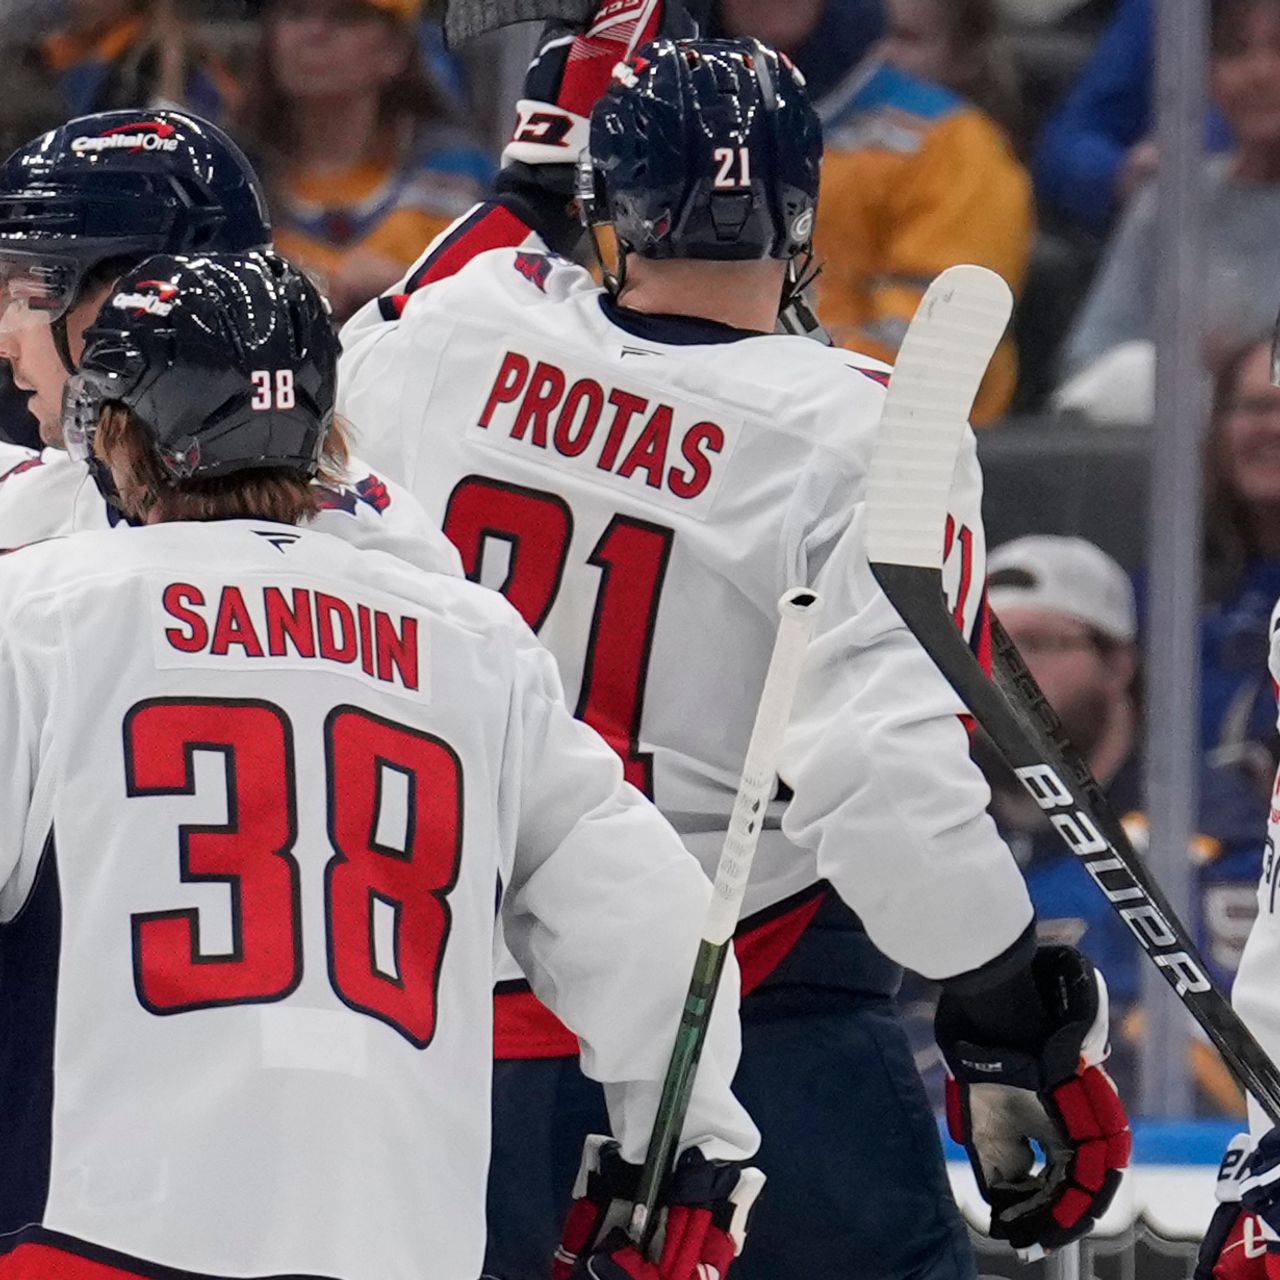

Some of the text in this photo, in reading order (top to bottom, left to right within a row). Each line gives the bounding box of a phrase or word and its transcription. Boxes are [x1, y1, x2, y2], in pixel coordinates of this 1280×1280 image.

[713, 147, 752, 188] 21
[250, 368, 297, 412] 38
[476, 350, 725, 500] PROTAS
[162, 581, 420, 692] SANDIN
[442, 473, 677, 804] 21
[121, 695, 465, 1051] 38
